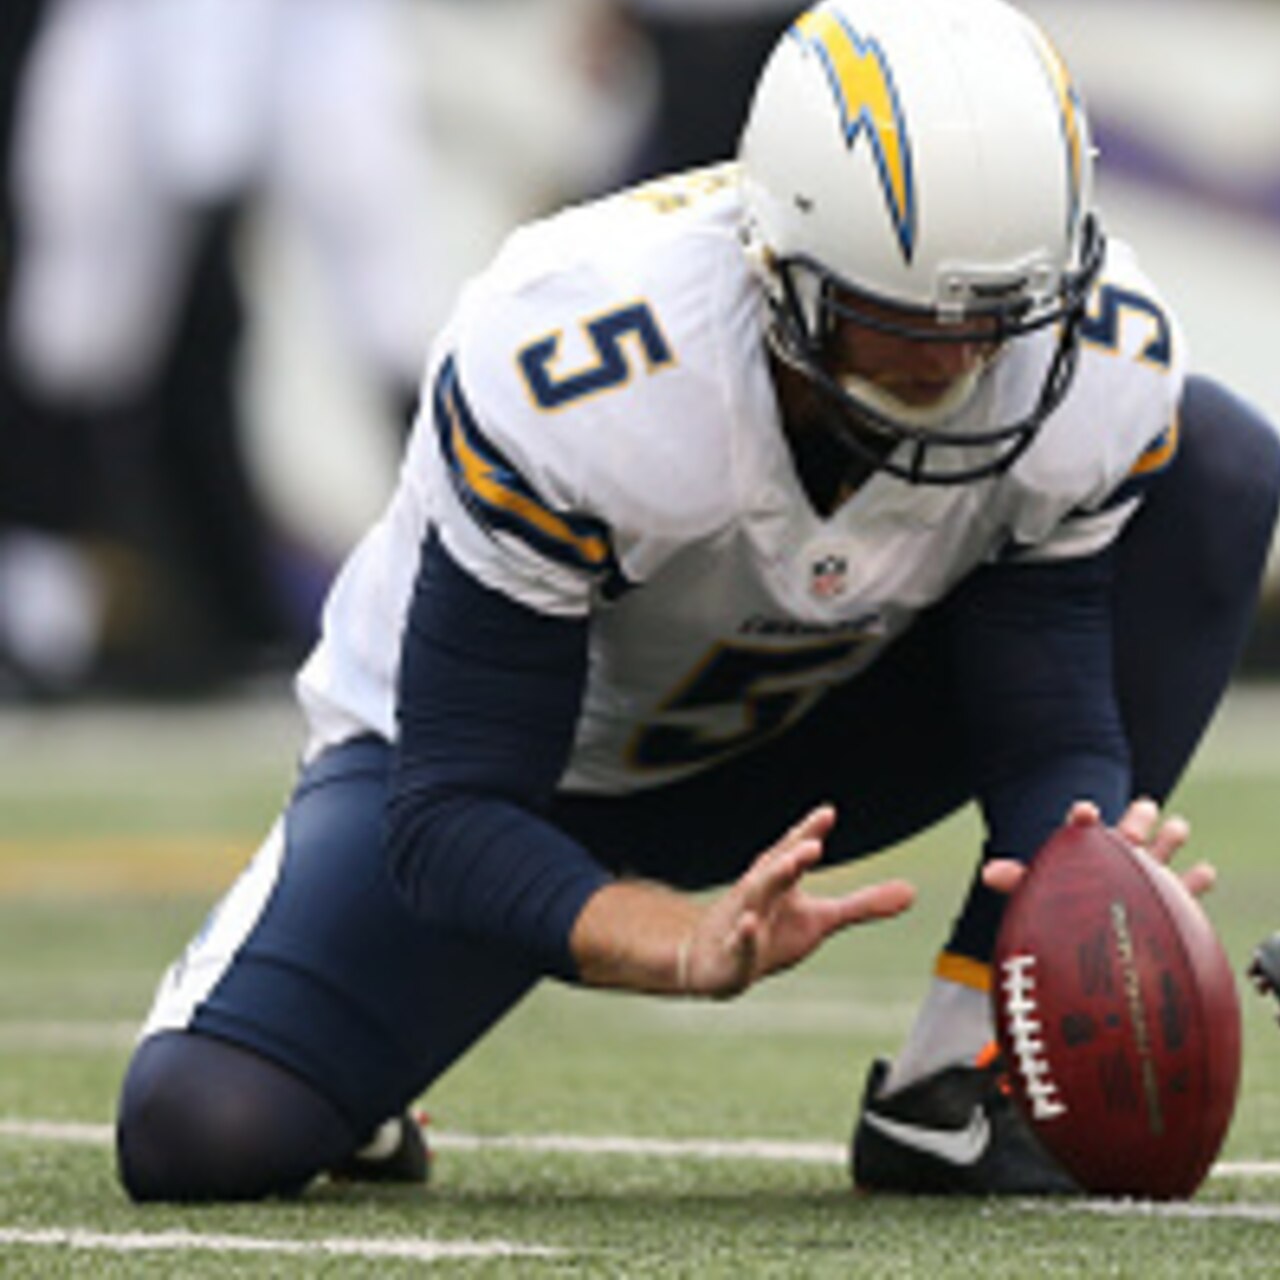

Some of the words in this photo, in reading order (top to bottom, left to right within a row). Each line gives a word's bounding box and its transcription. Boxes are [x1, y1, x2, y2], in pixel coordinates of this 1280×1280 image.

[513, 296, 679, 415] 5
[1056, 278, 1174, 374] 5
[622, 634, 882, 773] 5
